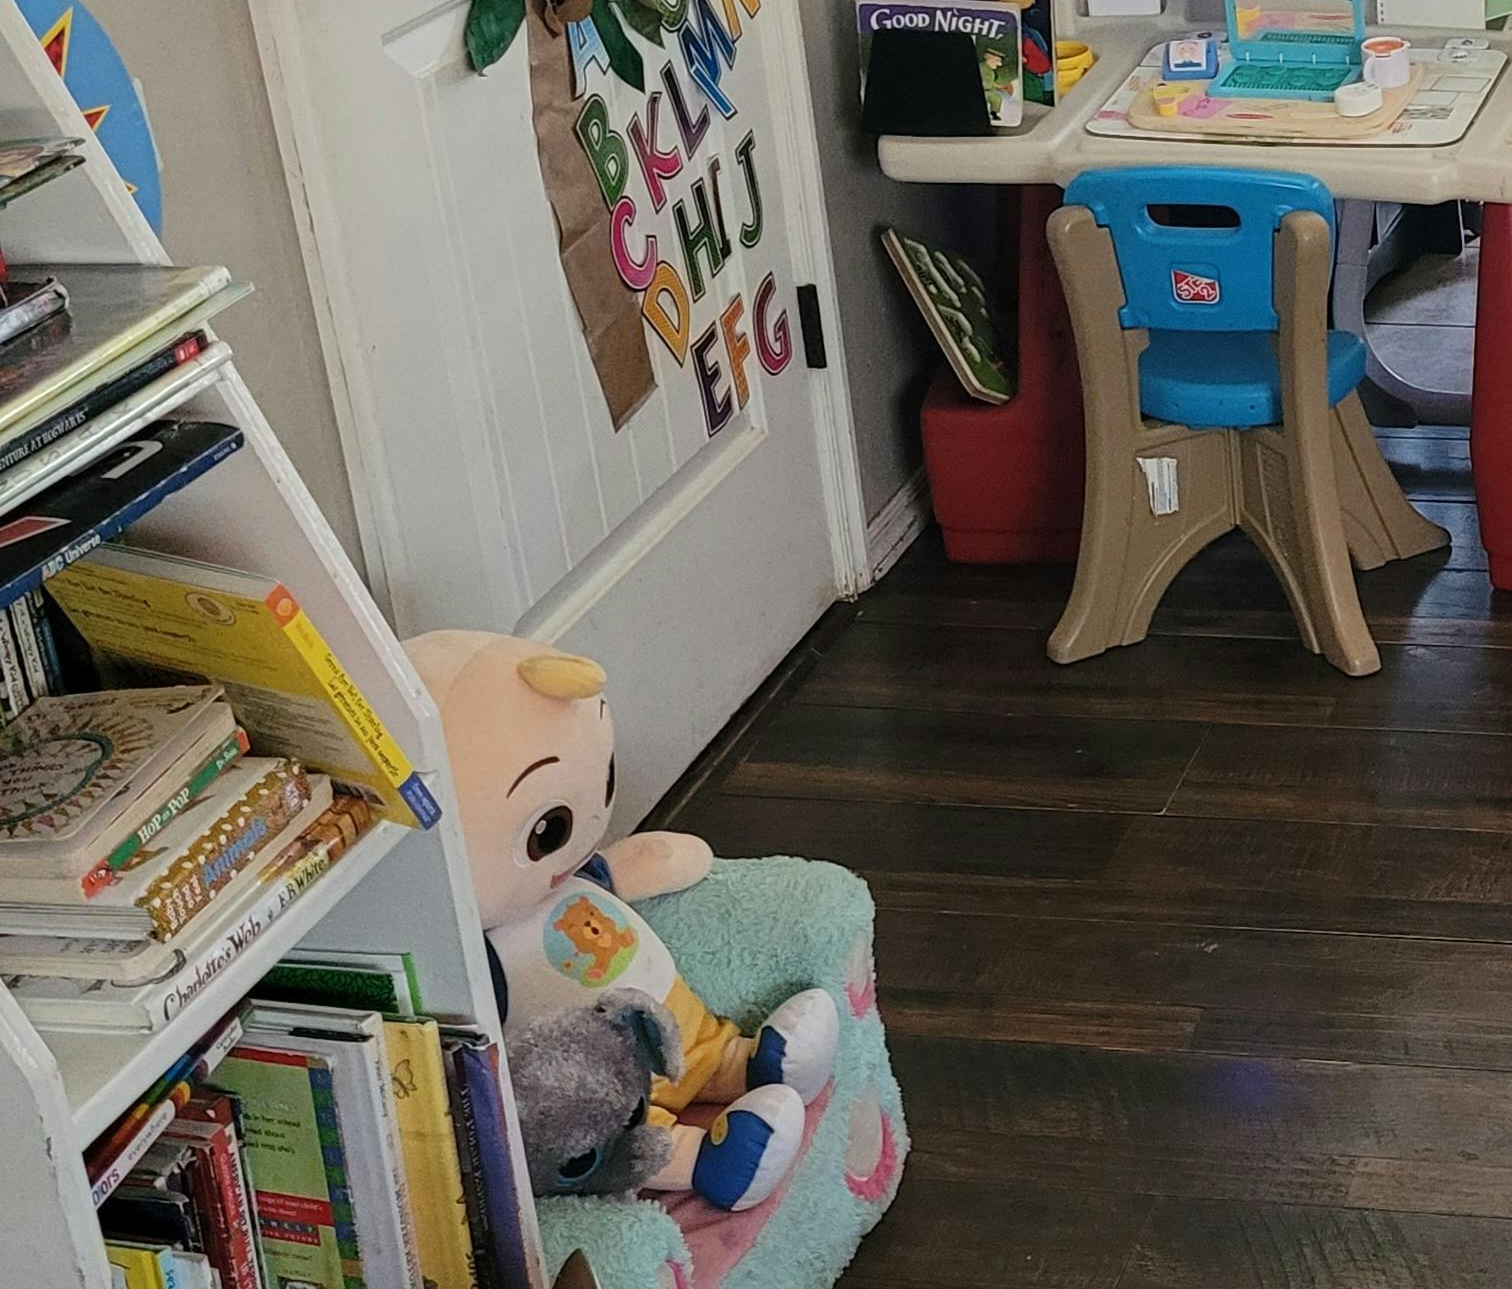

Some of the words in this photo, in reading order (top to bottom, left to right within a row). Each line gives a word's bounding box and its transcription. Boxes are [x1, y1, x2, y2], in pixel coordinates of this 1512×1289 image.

[870, 9, 930, 30] GOOD
[566, 19, 611, 99] A
[576, 93, 629, 208] B
[626, 91, 683, 213] K
[660, 60, 710, 159] L
[610, 197, 656, 289] C
[672, 177, 724, 302] H
[735, 129, 763, 248] J
[1199, 284, 1217, 301] 2
[642, 261, 690, 367] D
[691, 321, 735, 438] E
[719, 292, 749, 409] F
[753, 271, 792, 375] G
[30, 436, 42, 451] AT
[41, 411, 87, 445] HOGWARTS
[42, 555, 65, 581] ABC
[65, 533, 101, 563] Universe
[137, 816, 163, 844] HOP
[167, 788, 191, 816] POP
[202, 817, 267, 887] Animals
[163, 946, 232, 1022] Charlotte's
[227, 913, 261, 954] Web
[293, 857, 328, 892] White
[128, 1112, 168, 1161] everywhere
